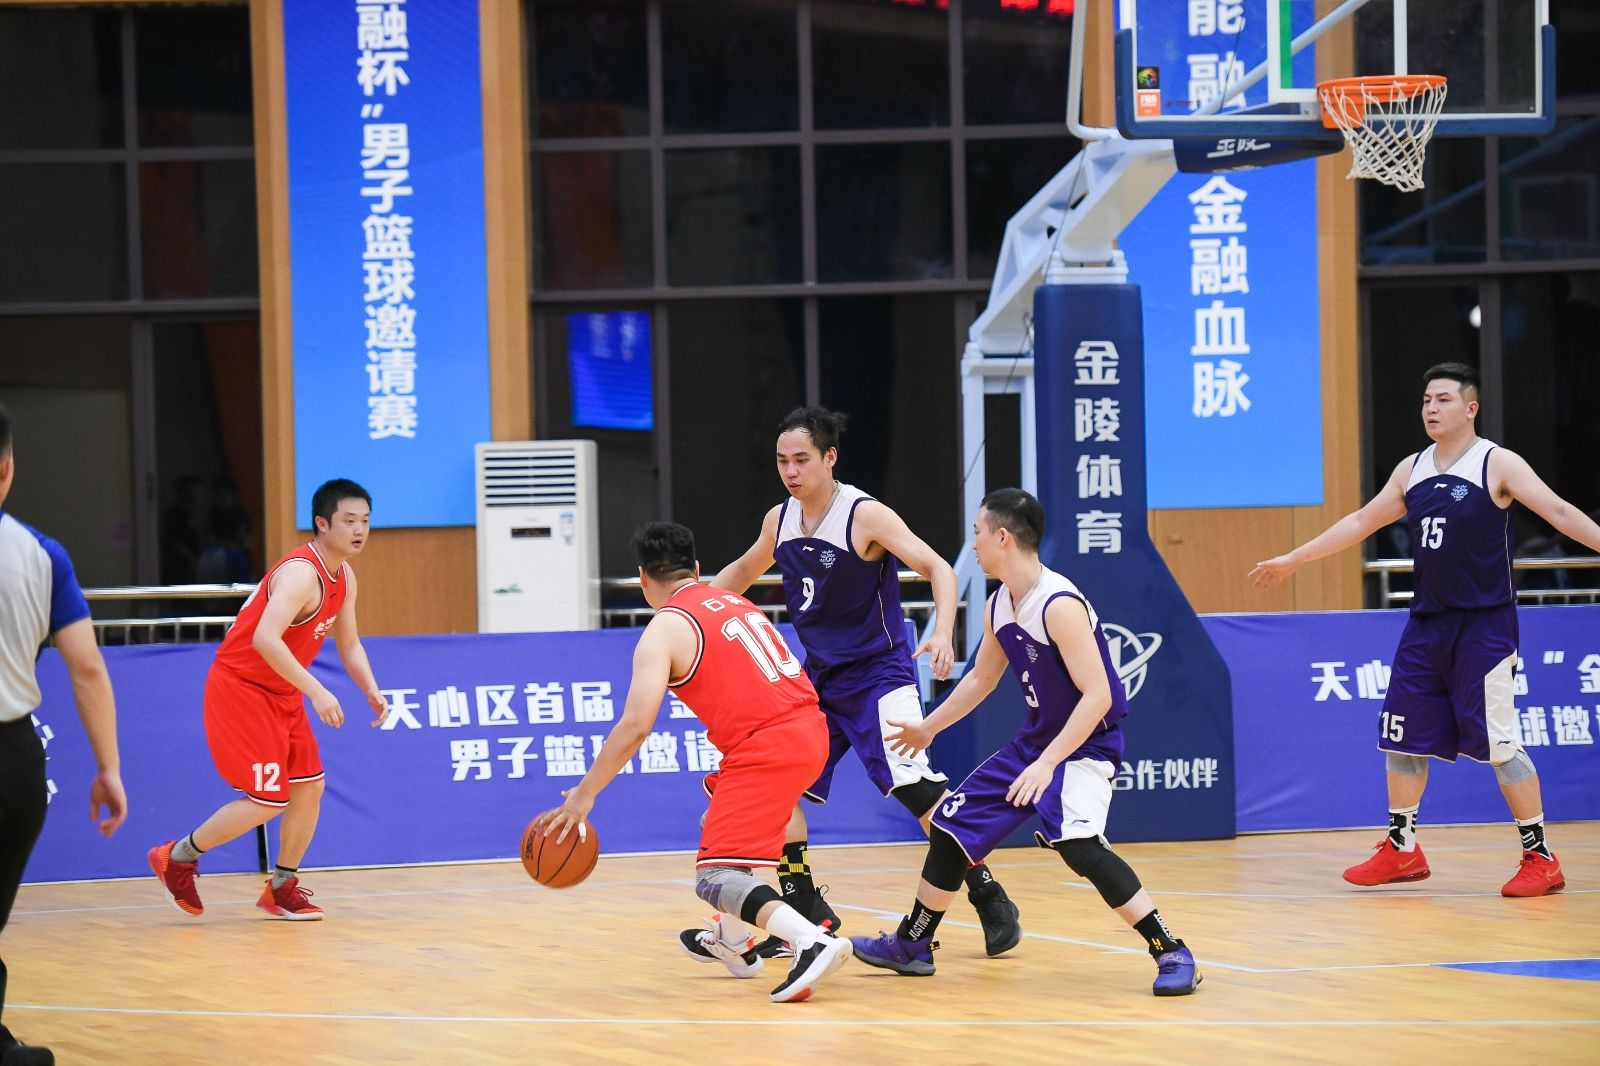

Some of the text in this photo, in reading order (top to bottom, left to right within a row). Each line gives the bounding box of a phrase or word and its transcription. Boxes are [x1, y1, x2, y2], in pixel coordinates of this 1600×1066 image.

[355, 0, 418, 439] 融杯”男子篮球邀请赛
[1188, 176, 1252, 418] 金融血脉
[1073, 340, 1123, 554] 金陵体育
[1420, 516, 1447, 550] 15
[799, 576, 815, 612] 9
[720, 612, 802, 684] 10
[378, 681, 615, 731] 天心区首届
[1380, 711, 1405, 743] 15
[252, 762, 281, 793] 12
[1111, 757, 1219, 791] 合作伙伴
[942, 792, 967, 819] 3
